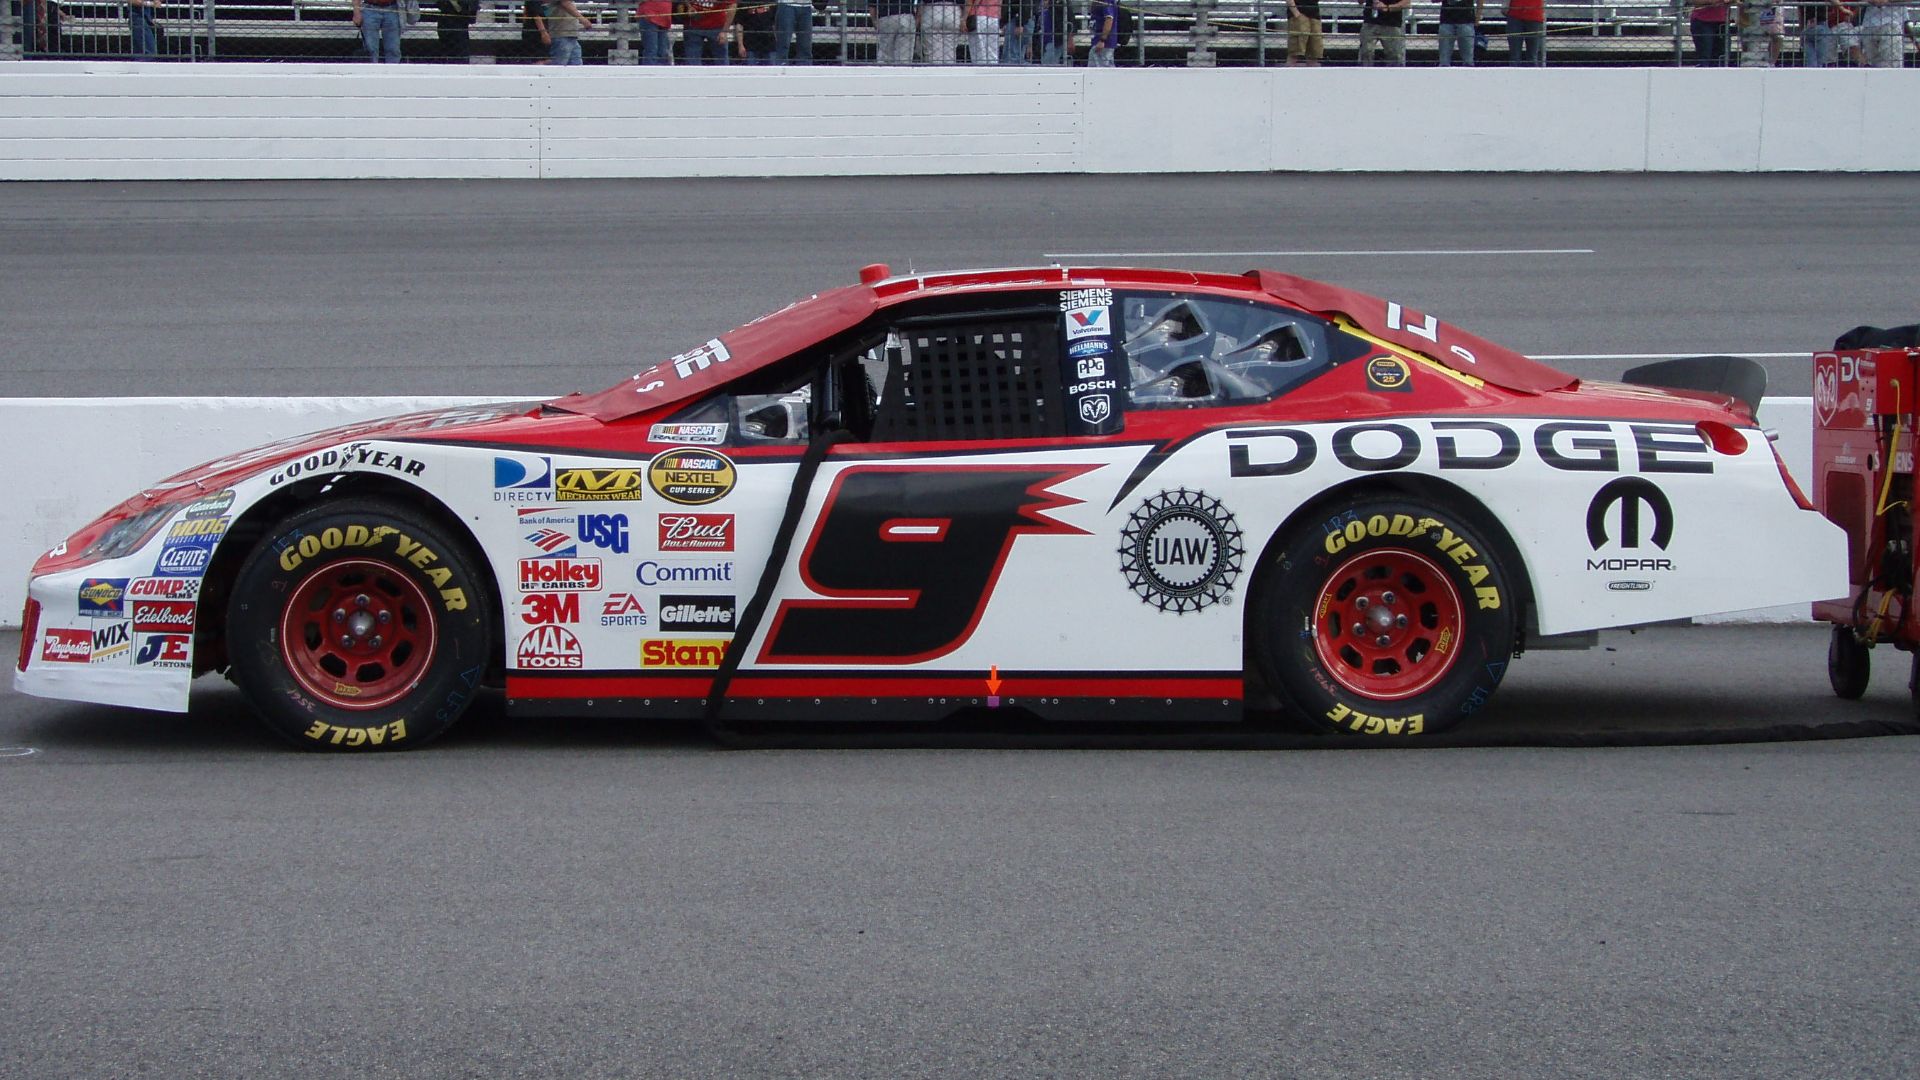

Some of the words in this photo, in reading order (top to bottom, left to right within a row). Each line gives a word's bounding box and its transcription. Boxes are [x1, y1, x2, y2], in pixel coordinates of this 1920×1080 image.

[1059, 288, 1113, 301] SIEMENS
[1059, 297, 1113, 311] SIEMENS
[1072, 326, 1104, 335] Valvoline
[1079, 358, 1103, 374] PPG
[1069, 380, 1116, 395] BOSCH
[678, 426, 713, 435] NASCAR
[1225, 421, 1714, 478] DODGE
[681, 458, 717, 469] NASCAR
[665, 472, 719, 483] NEXTEL
[494, 492, 552, 501] DIRECTV
[557, 490, 611, 501] MECHANIX
[612, 490, 641, 501] WEAR
[669, 486, 686, 494] CUP
[172, 517, 230, 537] MOOG
[578, 513, 629, 554] USG
[660, 516, 731, 539] Bud
[160, 547, 208, 566] CLEVITE
[1155, 538, 1209, 565] UAW
[754, 463, 1111, 665] 9
[1586, 559, 1672, 571] MOPAR
[520, 560, 600, 588] Holley
[636, 561, 732, 586] Commit
[130, 579, 184, 595] COMP
[542, 581, 585, 589] CARBS
[81, 588, 123, 600] SUNOCO
[521, 593, 580, 625] 3M
[602, 592, 645, 615] EA
[134, 605, 193, 625] Edelbrock
[601, 615, 647, 626] SPORTS
[660, 604, 733, 624] Gillette
[92, 621, 130, 650] WIX
[520, 626, 578, 655] MAC
[91, 649, 130, 664] FILTERS
[137, 635, 190, 665] JE
[519, 656, 581, 667] TOOLS
[1326, 702, 1424, 735] EAGLE
[304, 718, 407, 746] EAGLE
